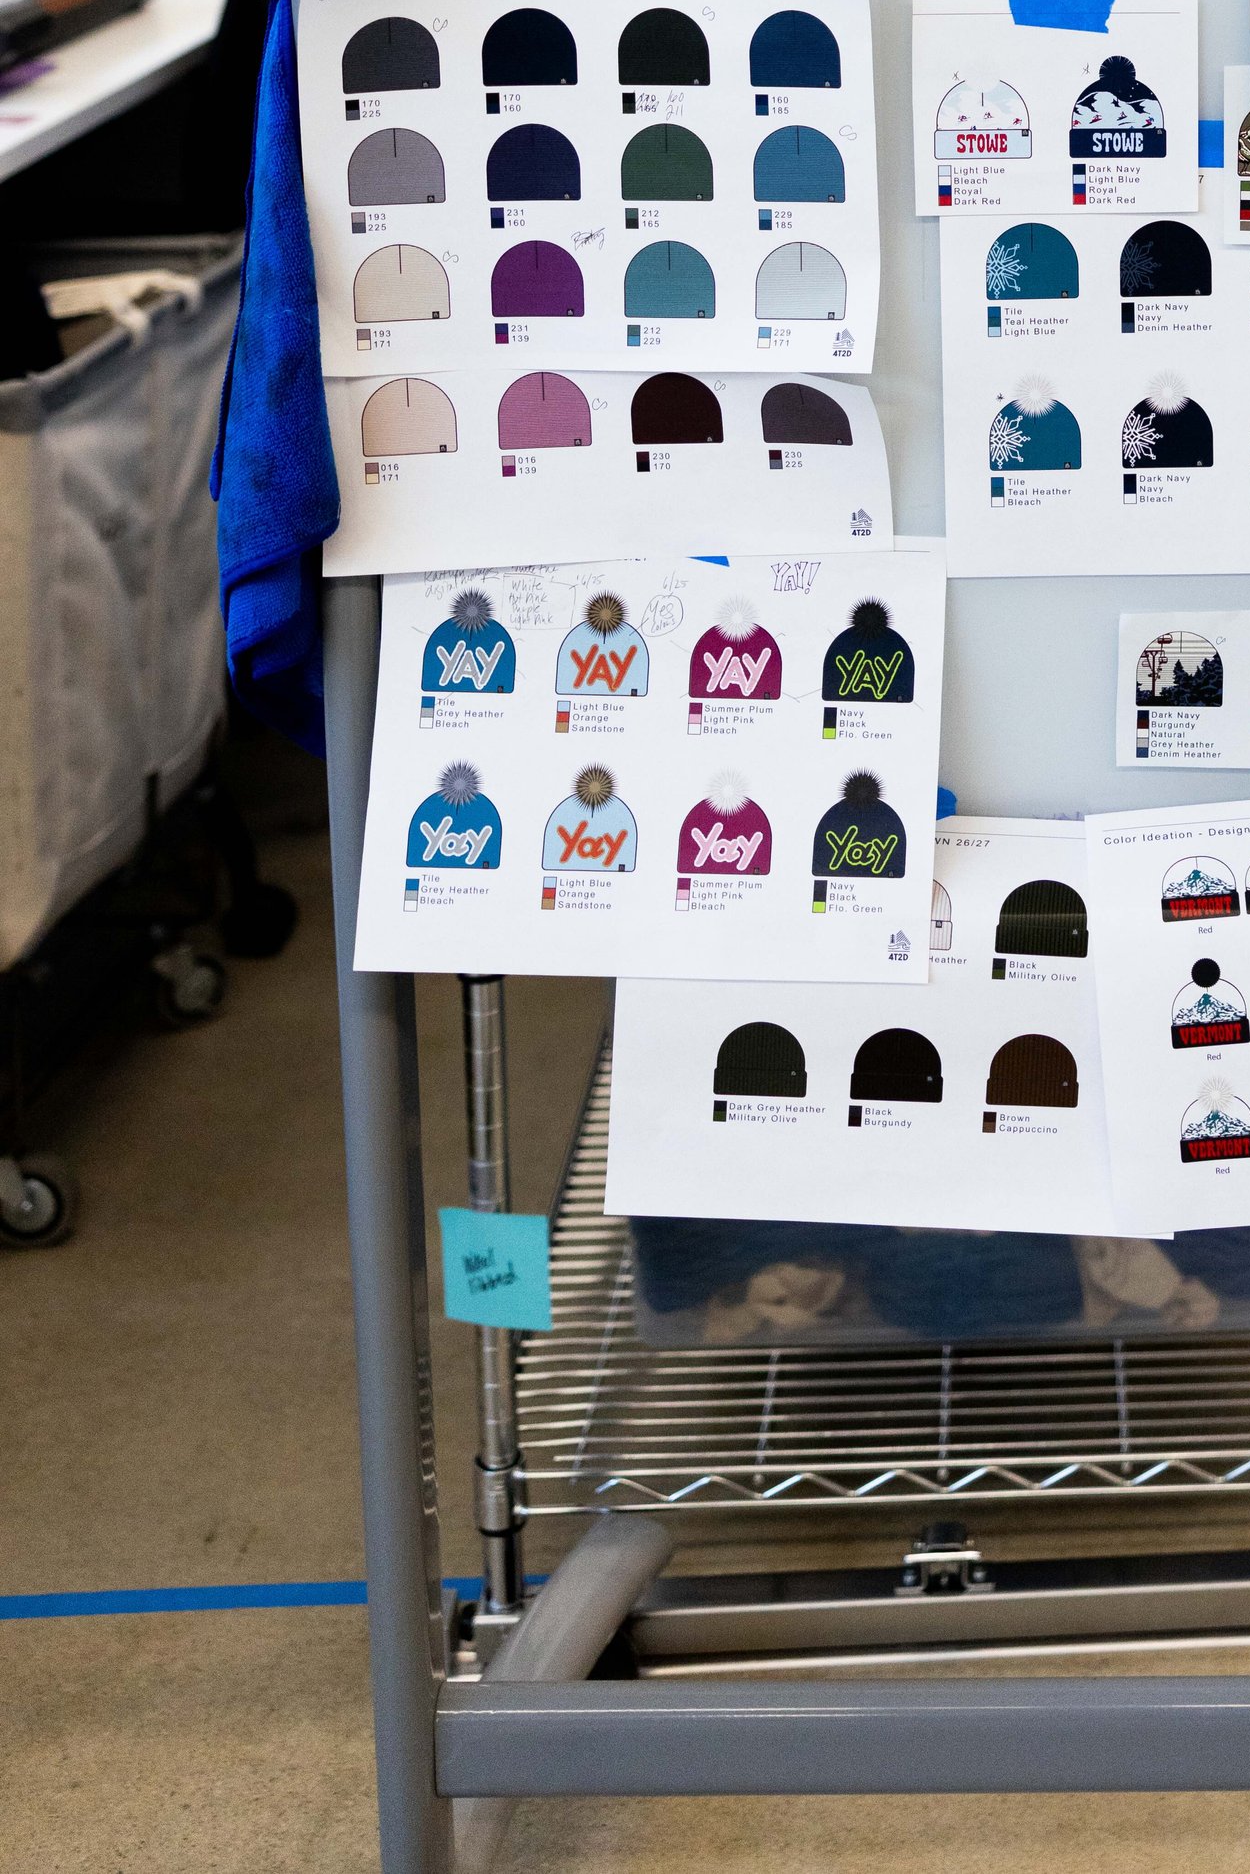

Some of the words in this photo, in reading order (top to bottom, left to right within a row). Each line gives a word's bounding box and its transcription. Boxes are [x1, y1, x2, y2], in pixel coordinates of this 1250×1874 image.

[956, 134, 1008, 153] STOWE
[1092, 132, 1144, 152] STOWE
[953, 166, 979, 178] Light
[983, 166, 1006, 175] Blue
[953, 187, 982, 199] Royal
[953, 197, 977, 206] Dark
[981, 197, 1001, 205] Red
[437, 641, 505, 689] YAY
[570, 643, 638, 692] YAY
[704, 647, 772, 696] YAY
[836, 650, 903, 699] YAY
[704, 704, 745, 714] Summer
[748, 705, 774, 714] Plum
[571, 723, 625, 733] Sandstone
[1151, 720, 1196, 733] Burgundy
[420, 816, 492, 865] Yay
[557, 820, 628, 867] Yay
[691, 822, 763, 870] Yay
[1103, 835, 1137, 846] Color
[1142, 831, 1193, 842] Ideation
[826, 825, 898, 874] Yay
[1170, 896, 1232, 918] VERMONT
[1198, 925, 1213, 935] Red
[1179, 1023, 1242, 1045] VERMONT
[998, 1123, 1058, 1138] Cappuccino
[1188, 1138, 1250, 1159] VERMONT
